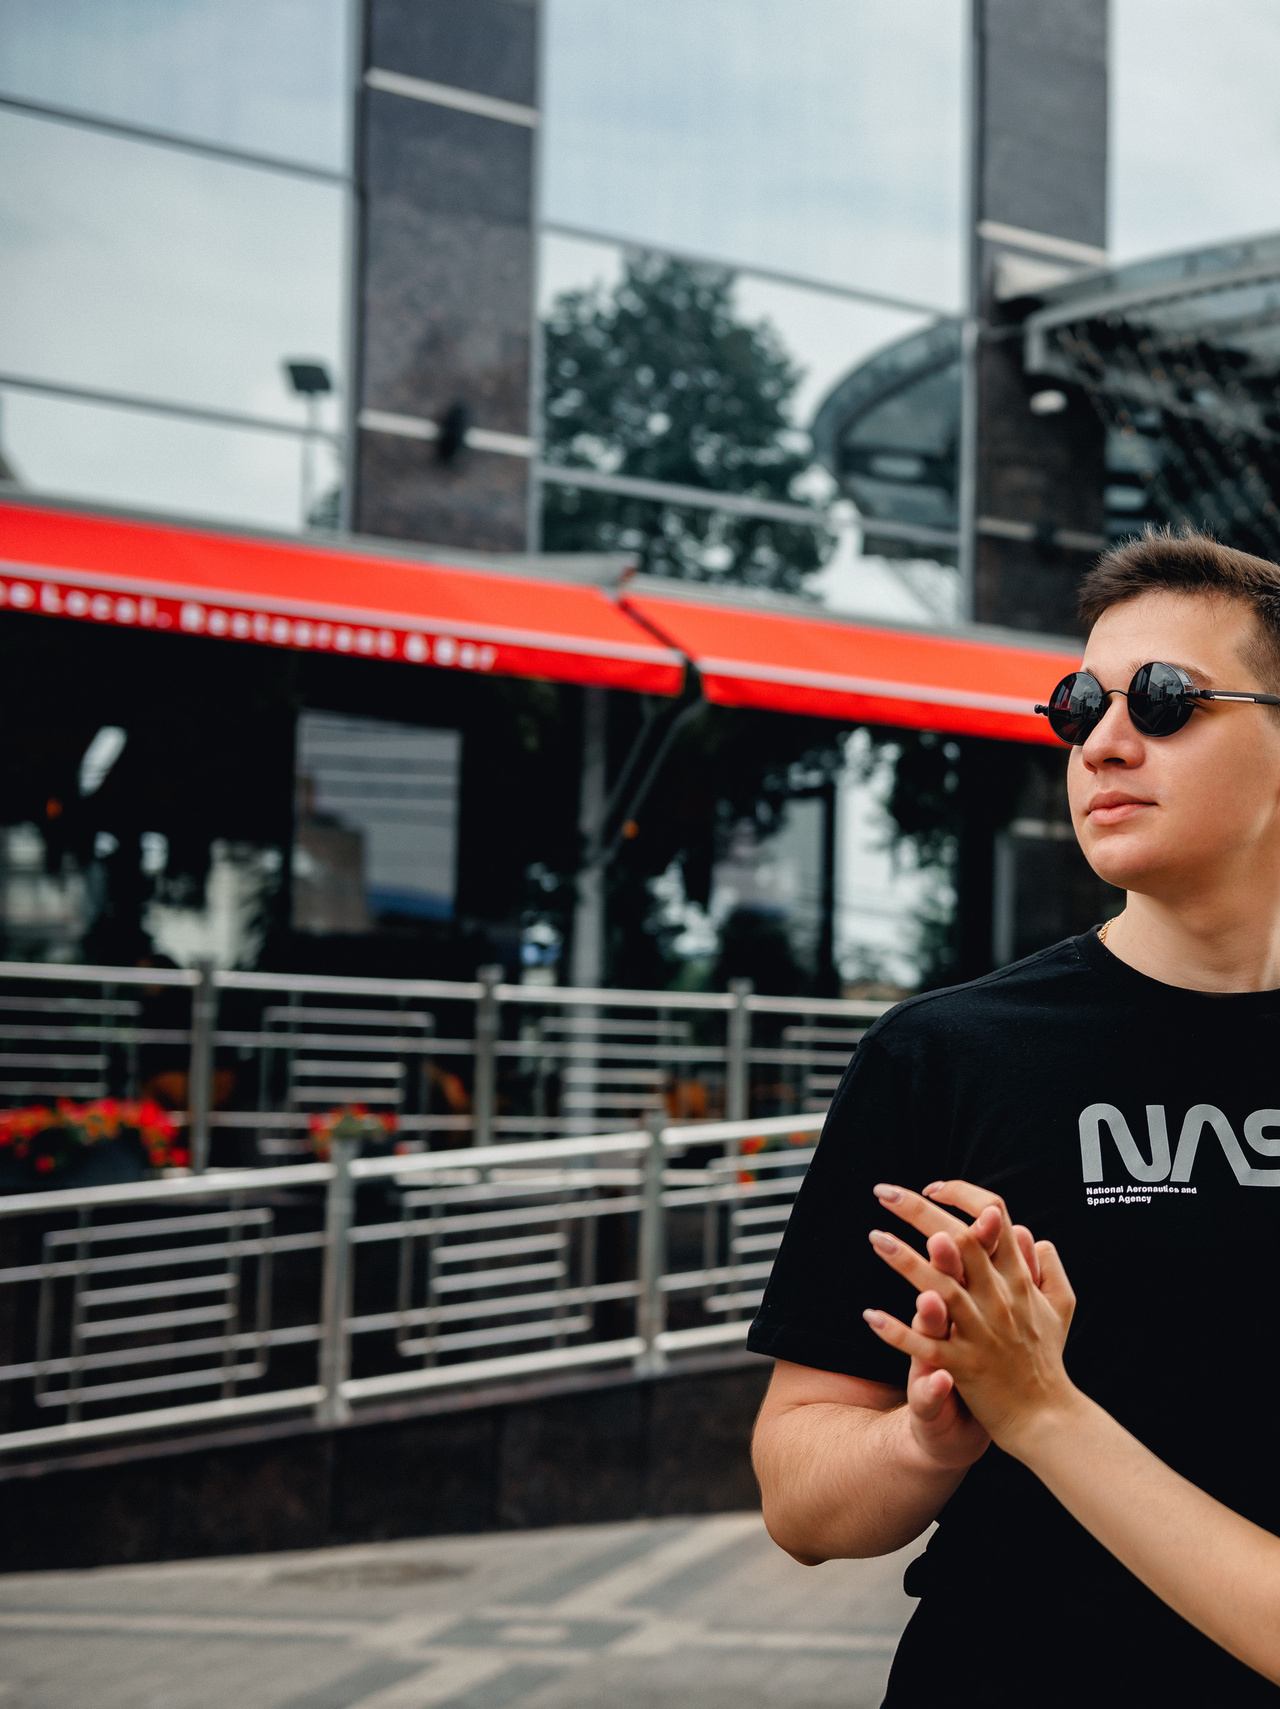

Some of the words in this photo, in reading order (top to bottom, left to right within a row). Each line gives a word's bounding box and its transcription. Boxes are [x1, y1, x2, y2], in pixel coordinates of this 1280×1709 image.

[180, 601, 396, 658] Restaurant
[433, 634, 498, 671] Bar
[1086, 1185, 1124, 1195] National
[1126, 1184, 1180, 1194] Aeronautics
[1181, 1186, 1198, 1194] and
[1086, 1196, 1116, 1206] Space
[1118, 1195, 1152, 1204] Agency
